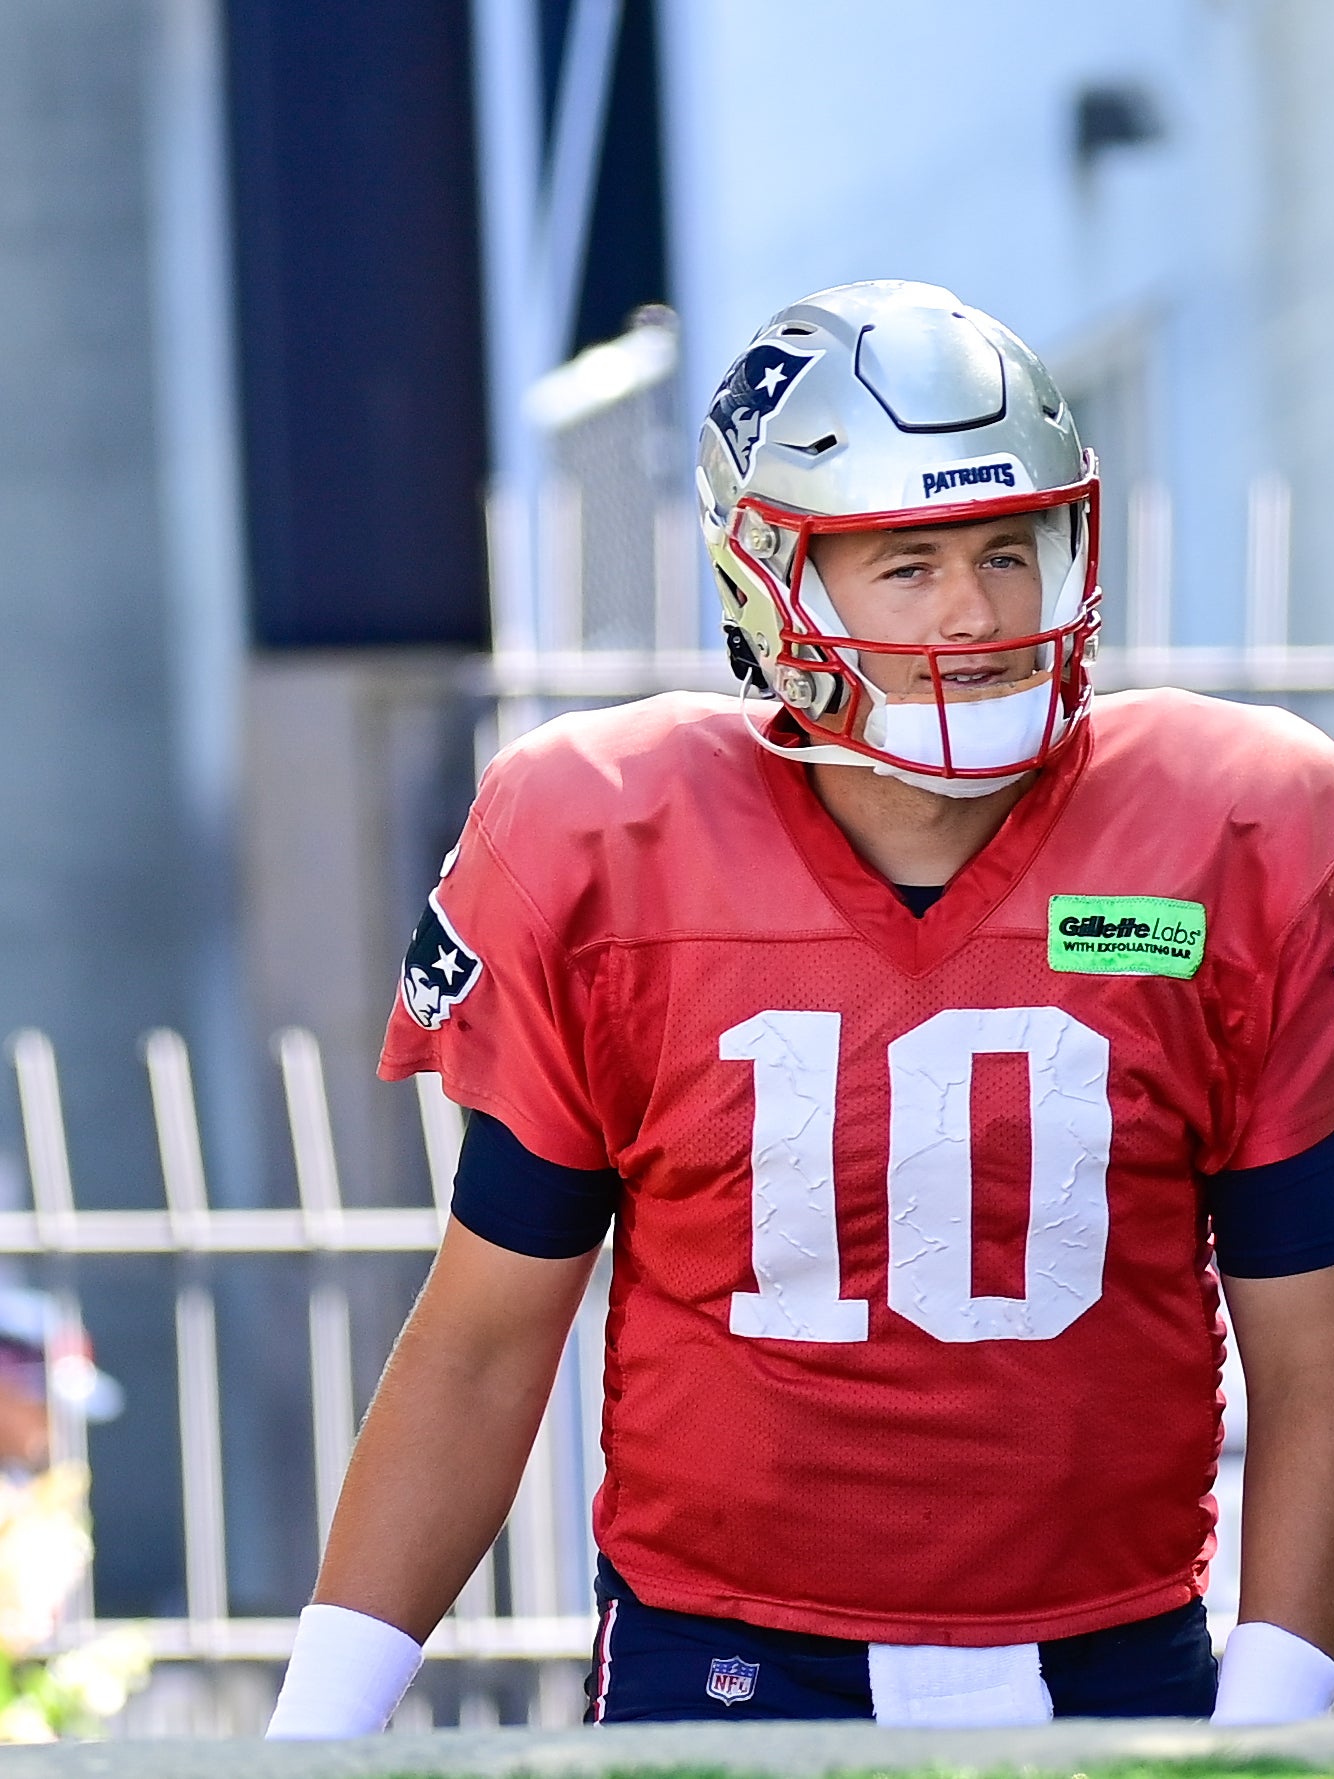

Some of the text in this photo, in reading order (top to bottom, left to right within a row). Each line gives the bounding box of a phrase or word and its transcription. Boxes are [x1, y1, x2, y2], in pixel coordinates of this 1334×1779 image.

[922, 463, 1016, 499] PATRIOTS
[1064, 941, 1192, 960] WITH EXFOLIATING BAR
[719, 1006, 1112, 1342] 10
[714, 1674, 748, 1694] NFL
